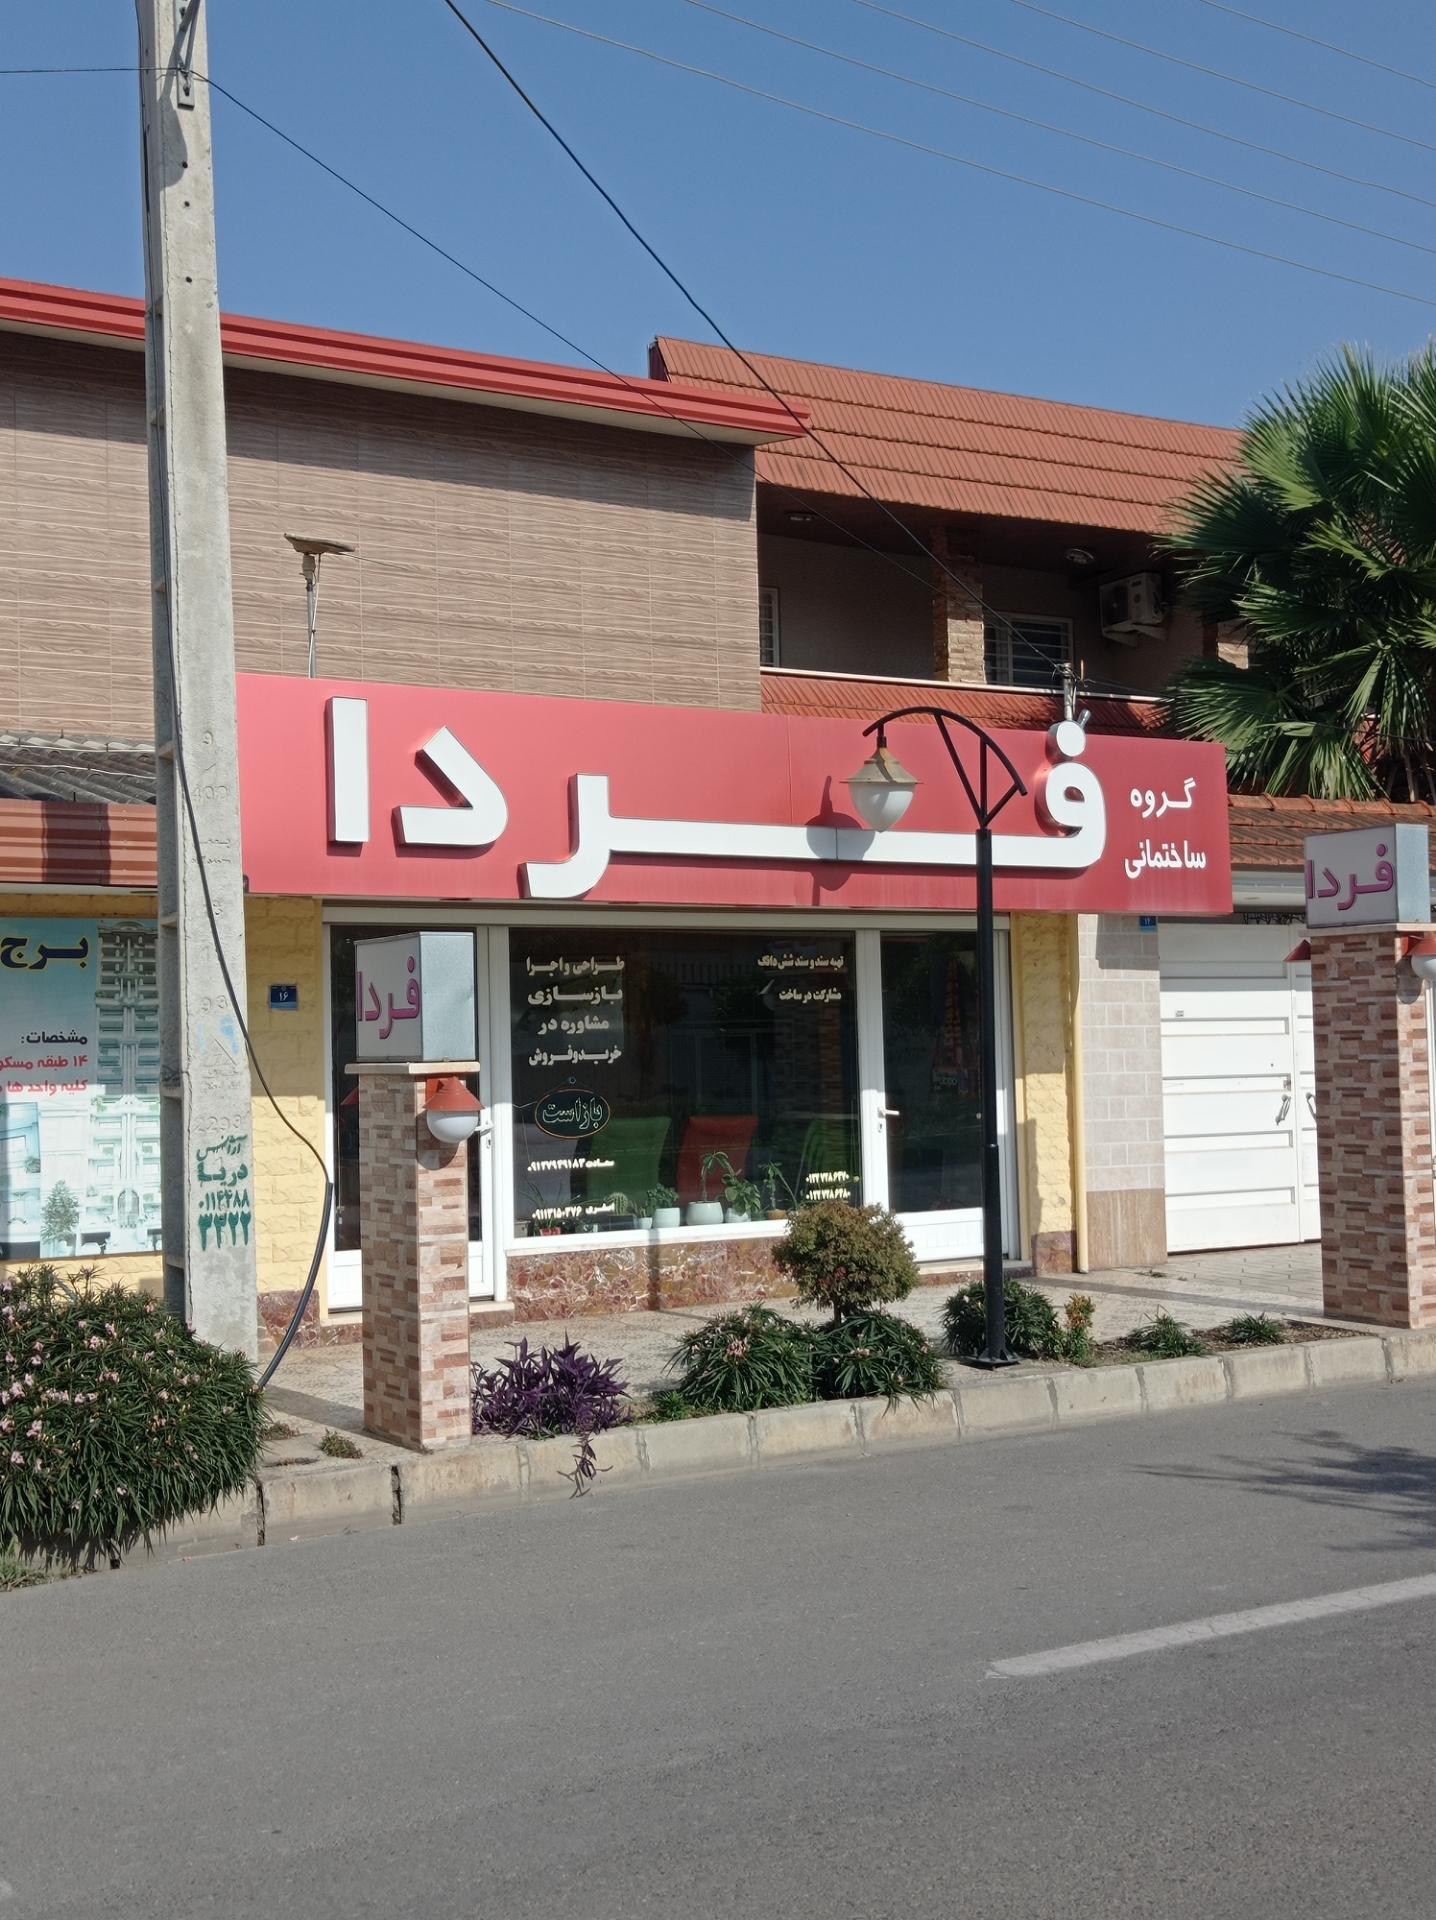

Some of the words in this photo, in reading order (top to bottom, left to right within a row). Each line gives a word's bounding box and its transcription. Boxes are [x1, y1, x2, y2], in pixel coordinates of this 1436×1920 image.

[326, 696, 1107, 900] فردا
[1130, 777, 1197, 818] گروه
[1124, 839, 1207, 879] ساختمانی
[1307, 843, 1394, 911] فردا
[0, 936, 89, 970] برج
[572, 955, 625, 976] طراحی
[356, 955, 421, 1040] فردا
[527, 985, 623, 1006] بازسازی
[779, 988, 802, 1000] ساخت
[813, 987, 842, 1003] مشارکت
[537, 1018, 558, 1035] در
[560, 1014, 610, 1034] مشاوره
[21, 1029, 88, 1045] مشخصات:
[37, 1055, 68, 1071] طبقه
[73, 1055, 88, 1067] ۱۴
[61, 1079, 88, 1096] کلیه
[542, 1097, 581, 1123] است
[579, 1097, 602, 1130] باز
[197, 1161, 248, 1187] دریا
